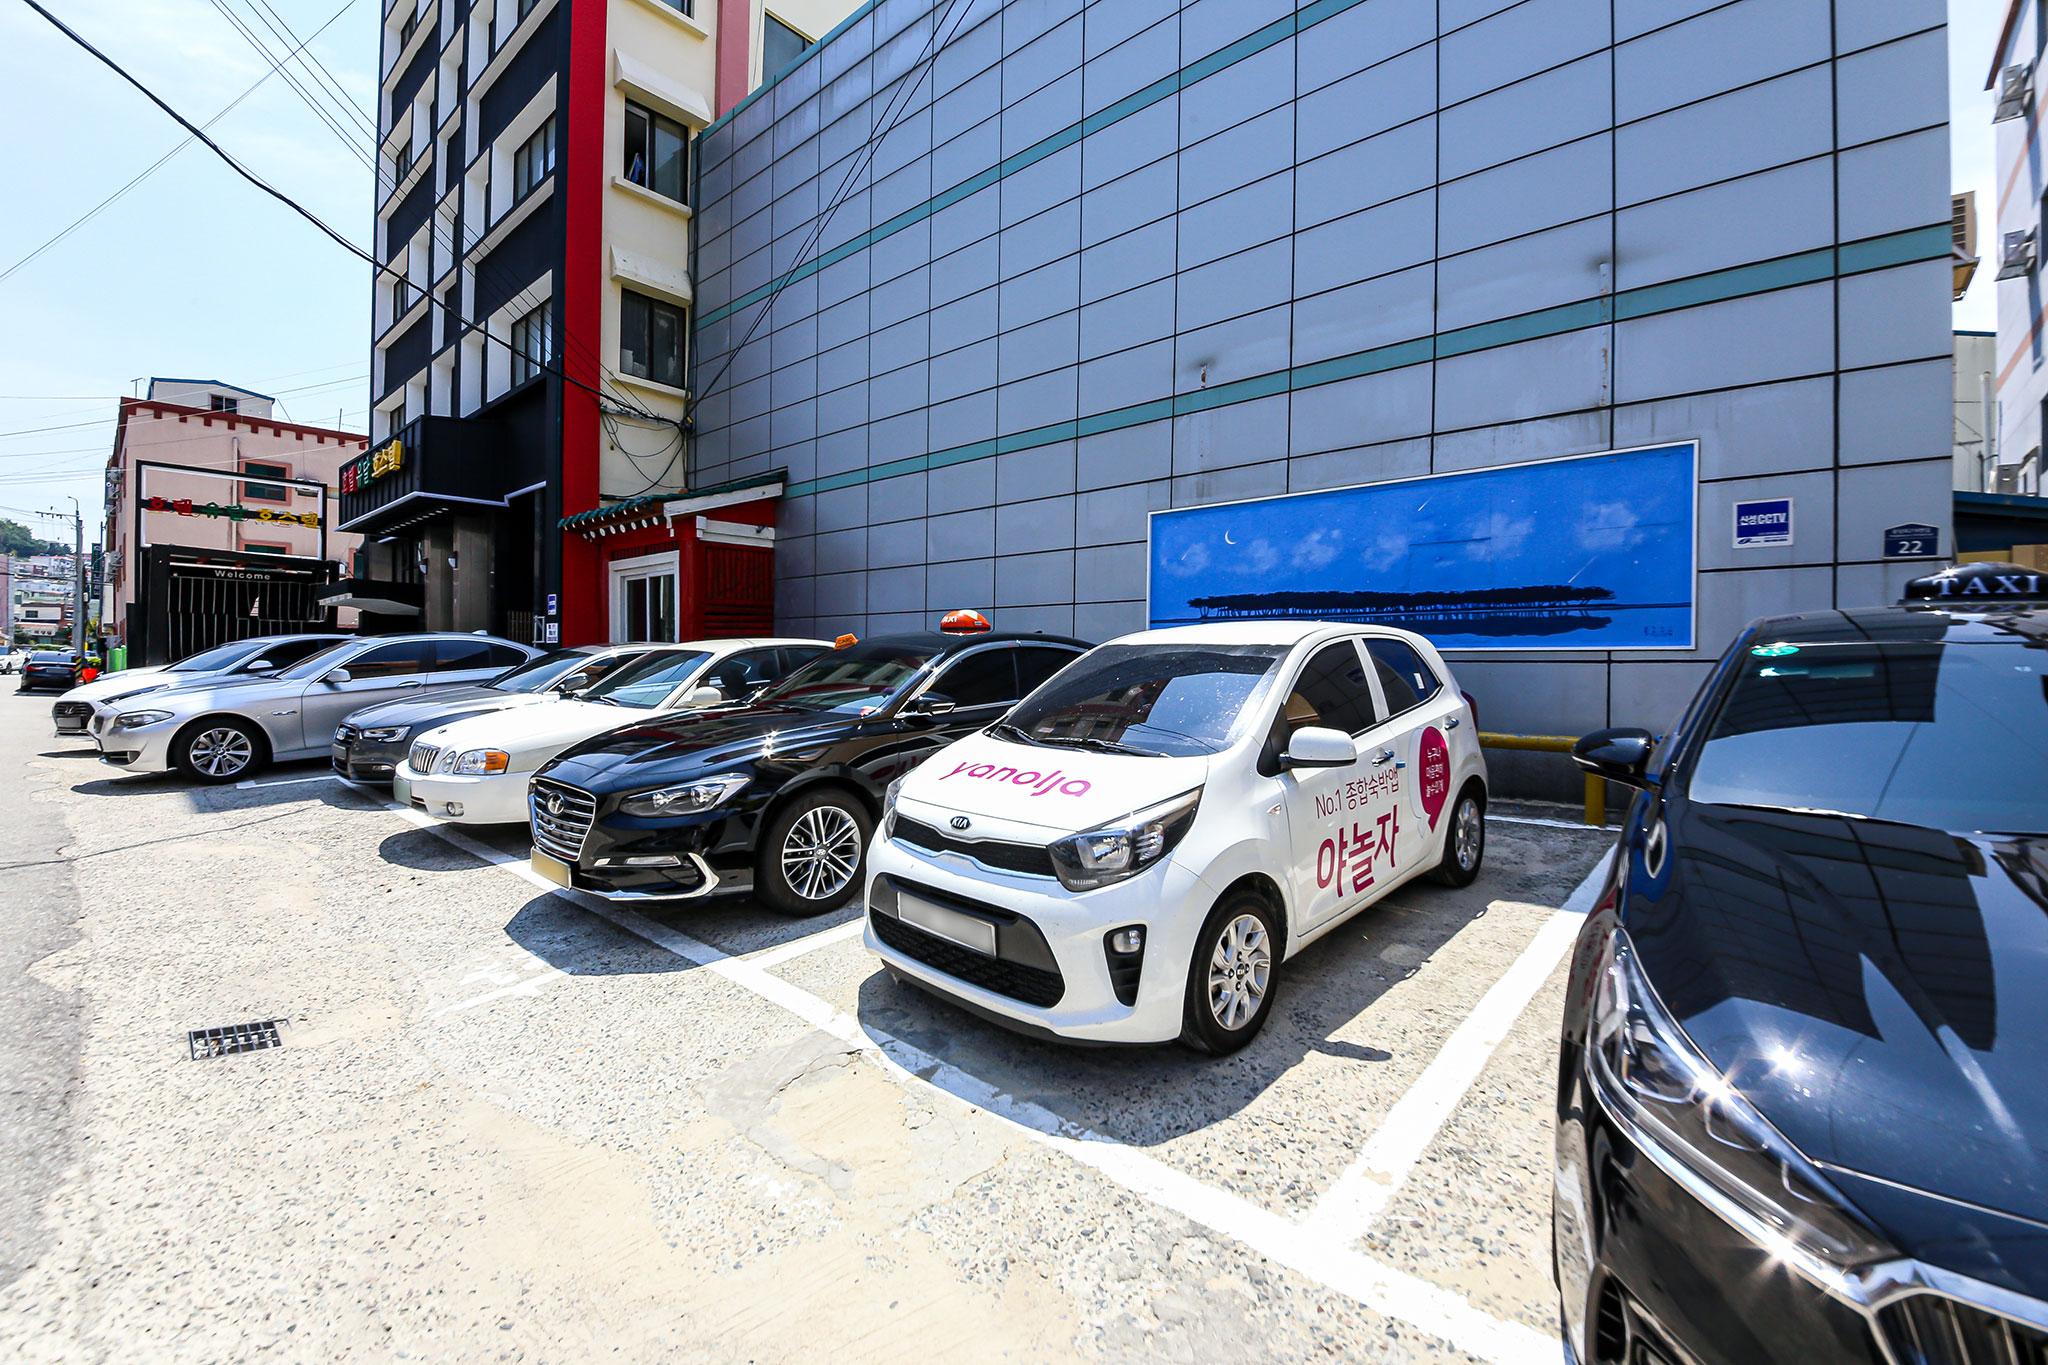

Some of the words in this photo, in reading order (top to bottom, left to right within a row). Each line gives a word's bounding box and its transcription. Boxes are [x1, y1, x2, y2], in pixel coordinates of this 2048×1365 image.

[371, 439, 401, 478] 호스텔
[256, 508, 319, 529] 호스텔
[1898, 540, 1923, 554] 22
[214, 569, 271, 581] Welcome
[1932, 575, 2041, 596] TAXI
[938, 761, 1092, 798] yanolja
[1315, 789, 1343, 819] No.1
[1345, 767, 1400, 810] 종합숙박앱
[951, 817, 969, 829] KIA
[1316, 804, 1400, 898] 야놀자
